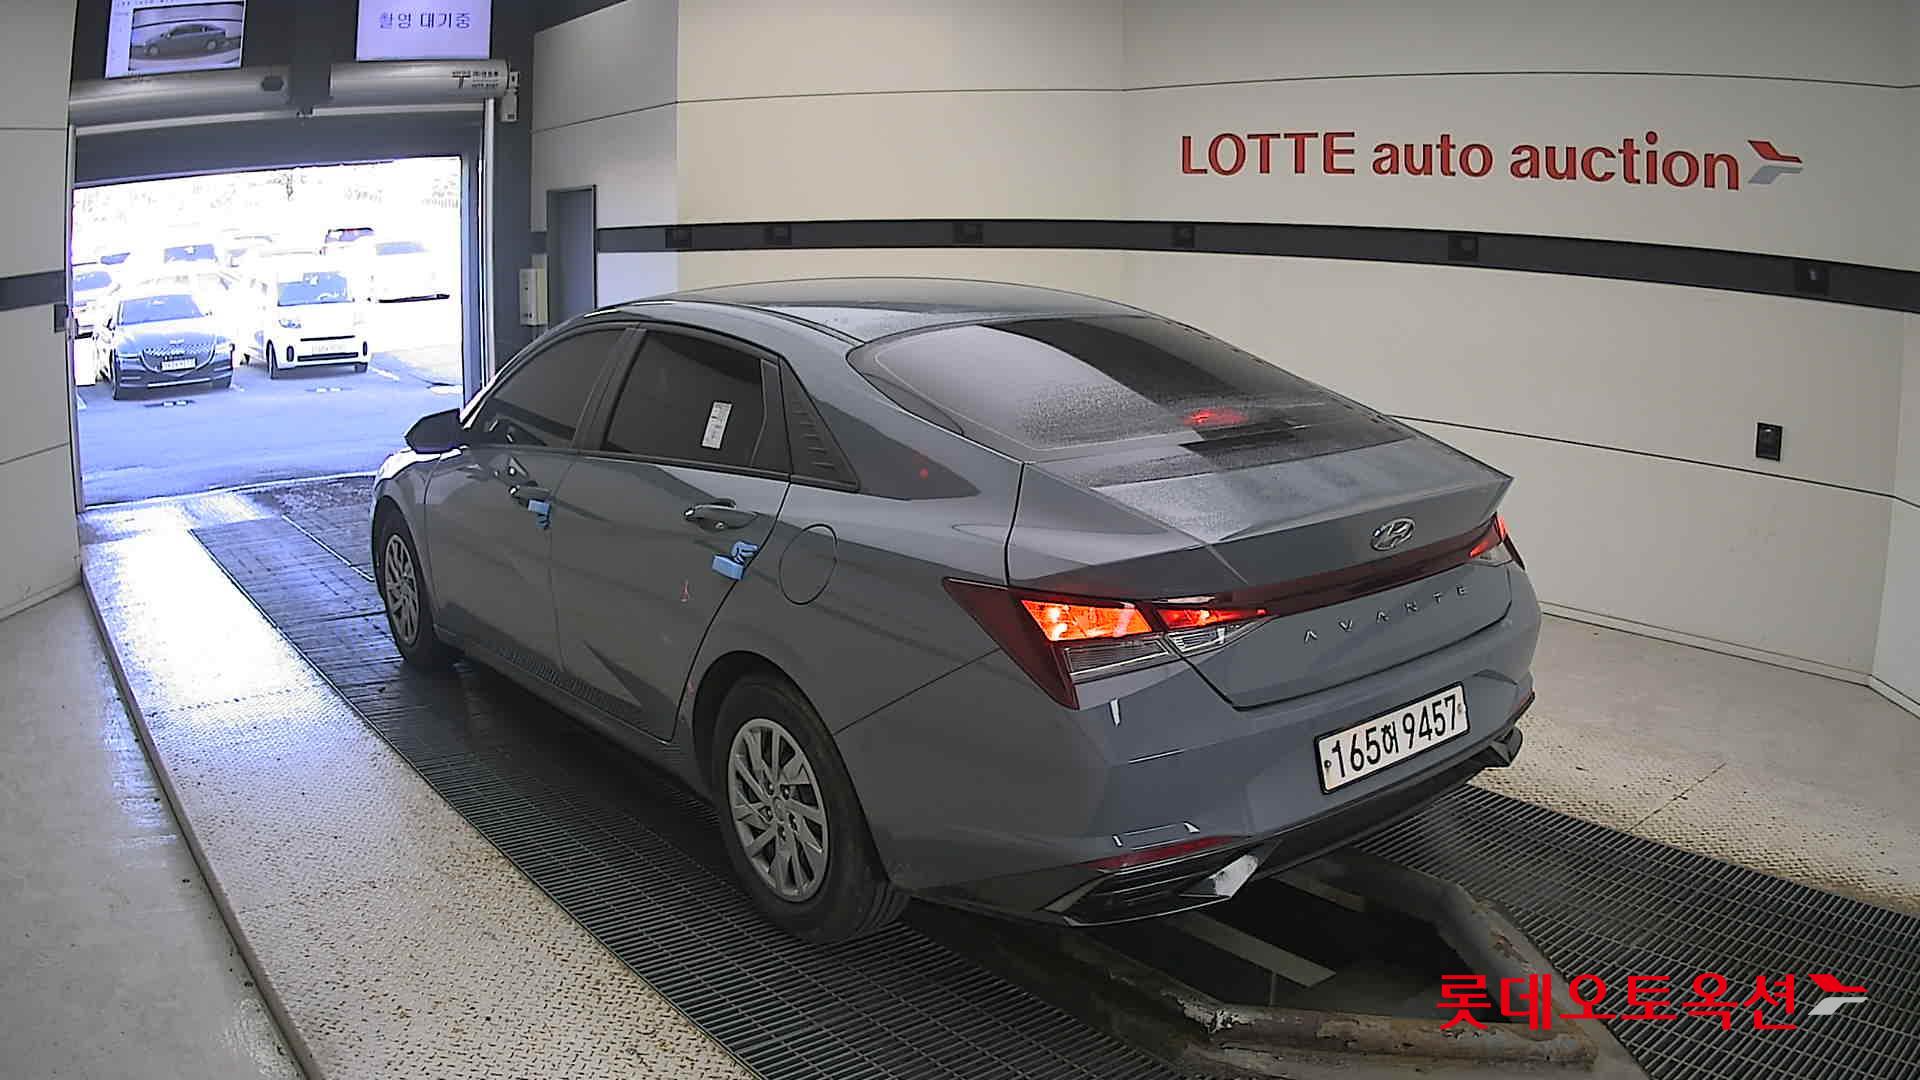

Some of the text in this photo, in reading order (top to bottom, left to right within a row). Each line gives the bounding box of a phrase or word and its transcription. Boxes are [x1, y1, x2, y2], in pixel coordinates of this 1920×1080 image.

[420, 12, 471, 30] 대기중
[1181, 130, 1740, 190] LOTTE auto auction
[1303, 585, 1468, 643] AVANTE
